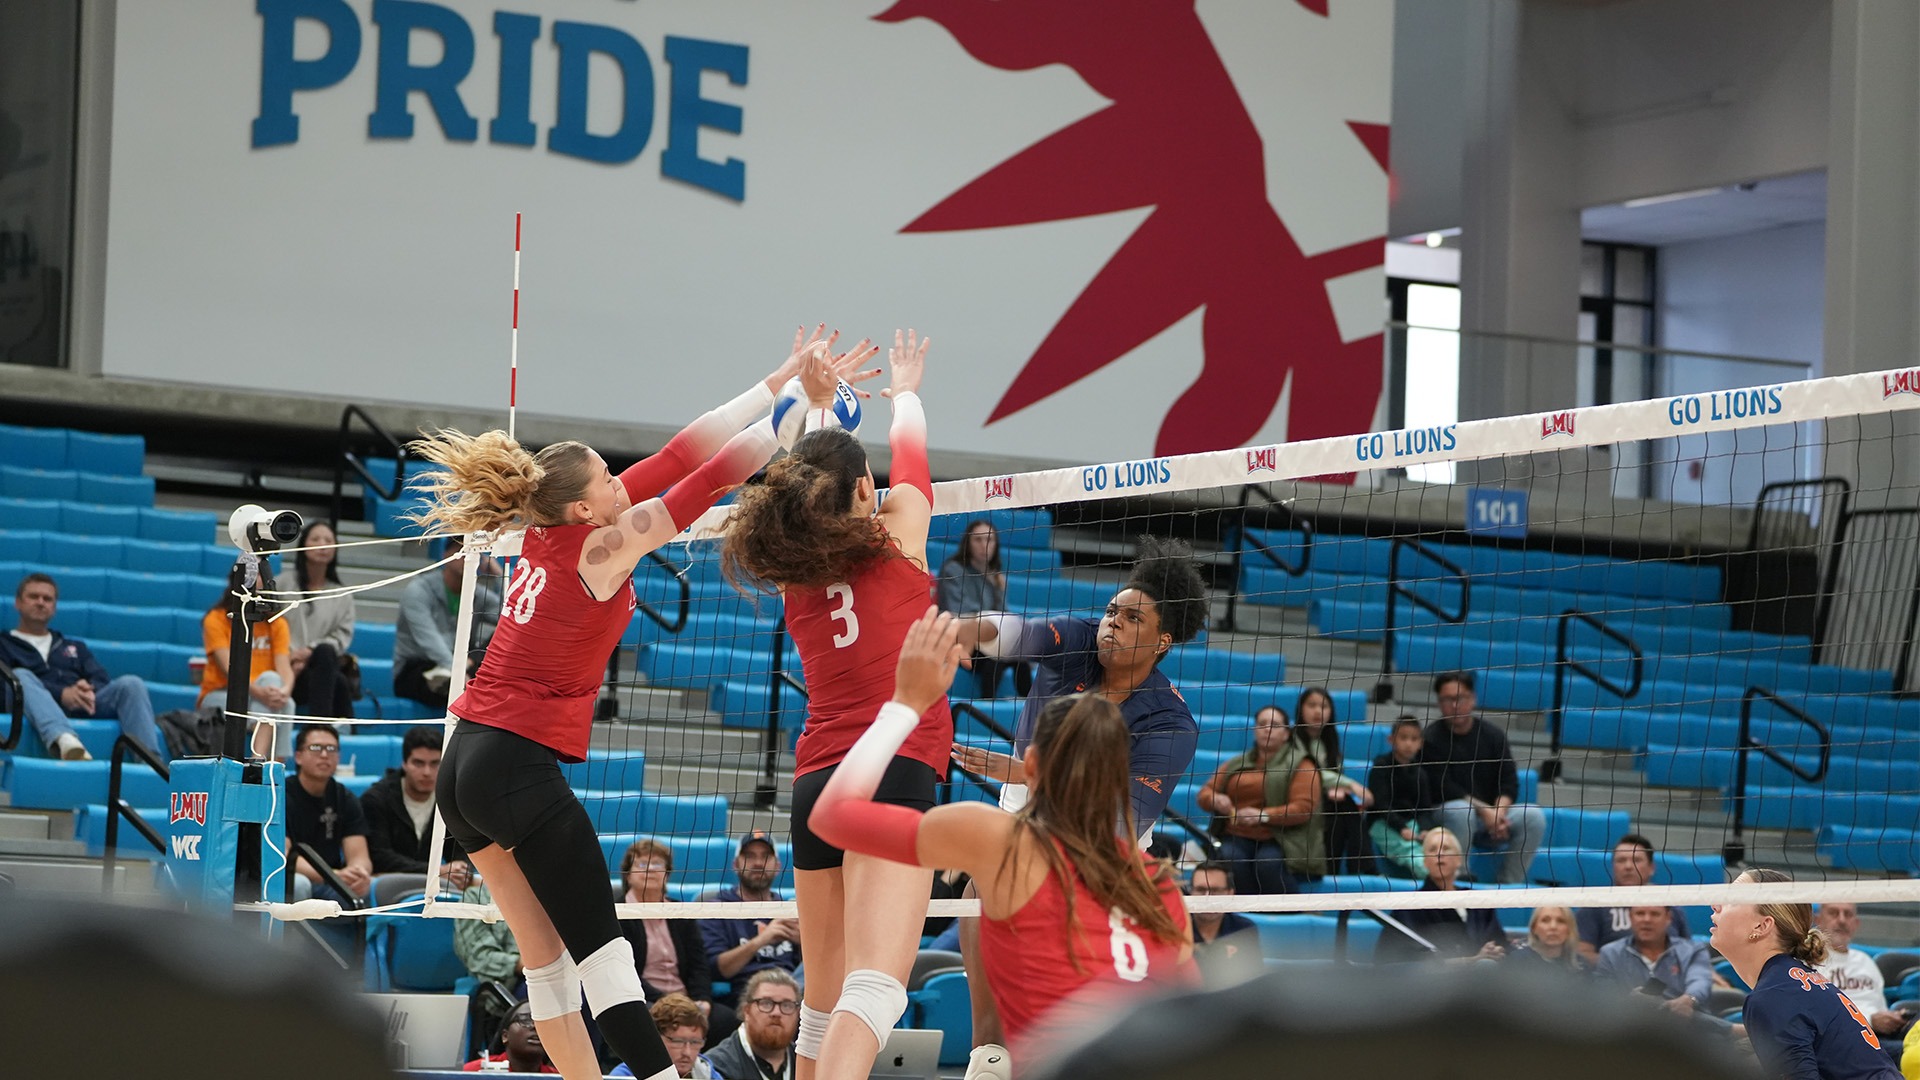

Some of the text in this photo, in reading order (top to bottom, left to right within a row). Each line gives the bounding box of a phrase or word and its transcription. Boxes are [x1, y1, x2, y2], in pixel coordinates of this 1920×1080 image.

[251, 0, 749, 203] PRIDE
[1882, 370, 1920, 401] LMU
[1669, 386, 1782, 425] GO LIONS
[1356, 424, 1456, 461] GO LIONS
[1541, 412, 1577, 440] LMU
[1083, 459, 1171, 492] GO LIONS
[1247, 448, 1276, 475] LMU
[984, 476, 1014, 502] LMU
[1476, 501, 1518, 524] 101
[501, 558, 546, 624] 28
[827, 582, 859, 648] 3
[170, 792, 208, 826] LMU
[171, 835, 202, 860] WCC
[1109, 906, 1149, 982] 6
[1837, 993, 1881, 1050] 9
